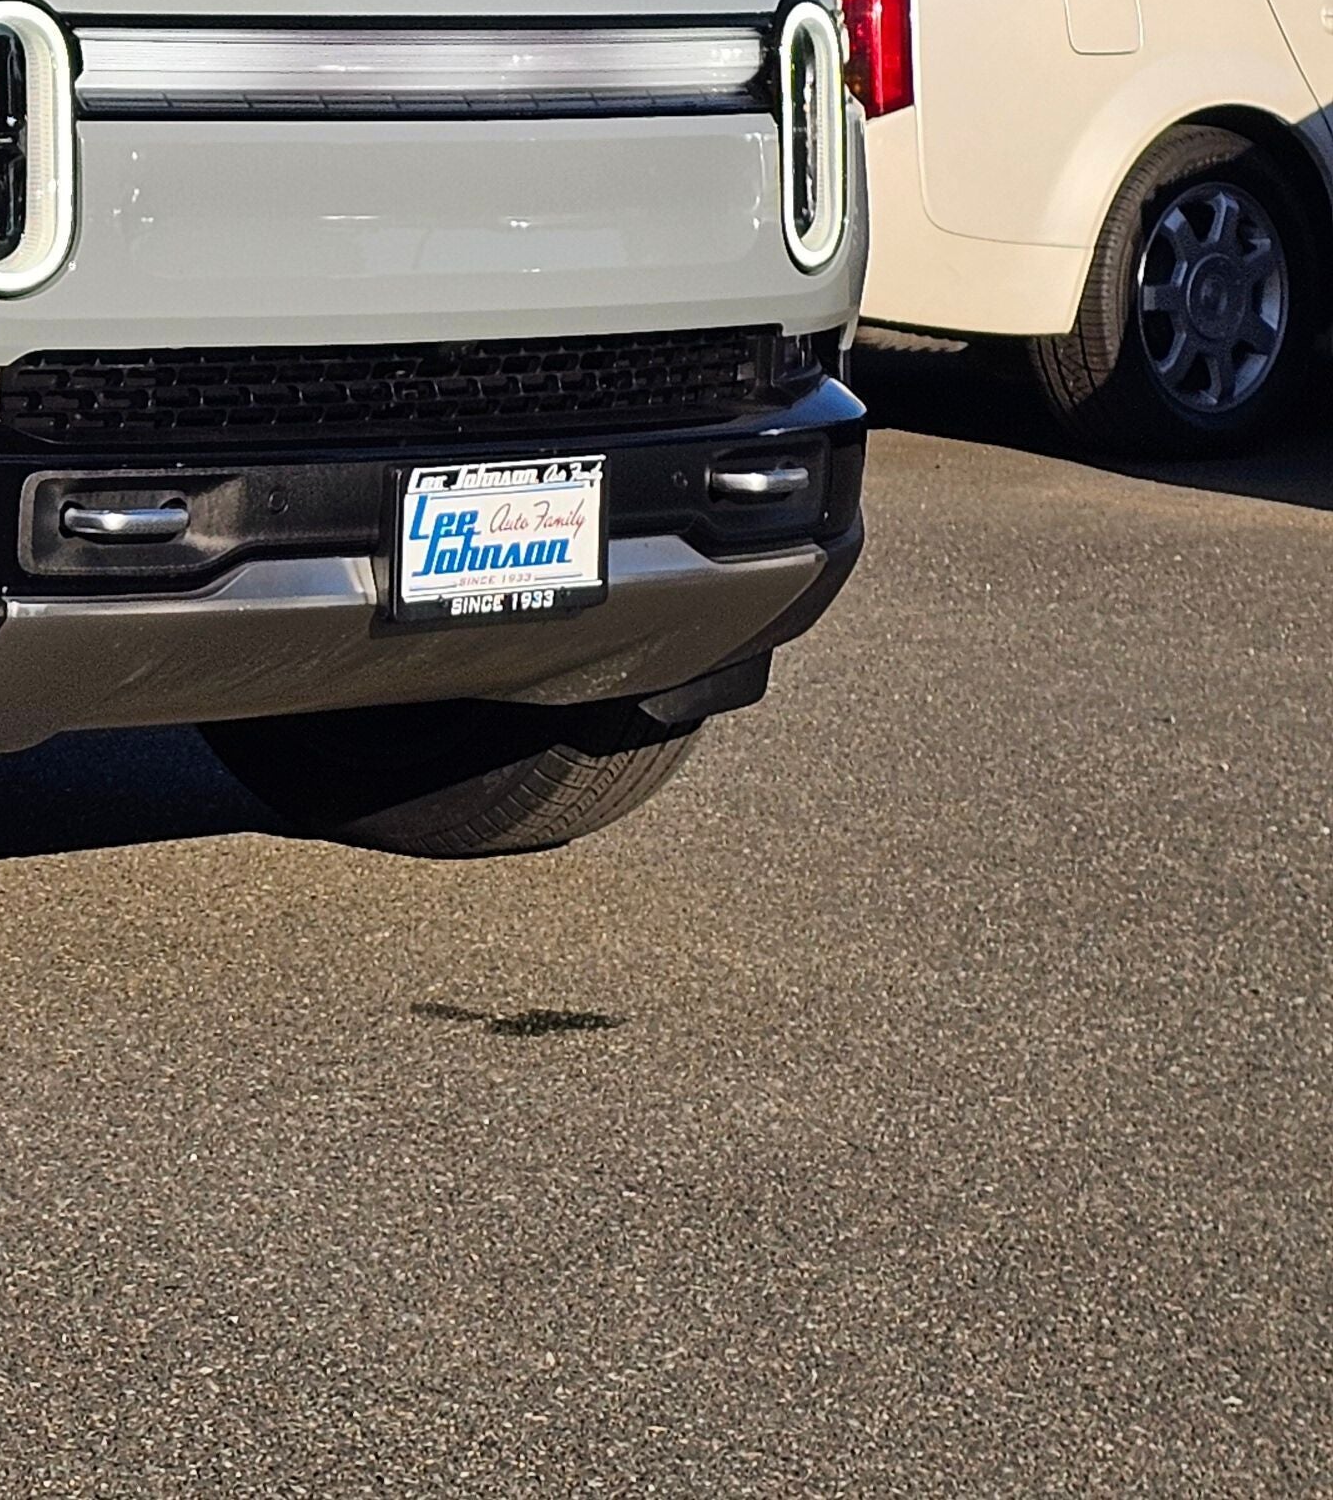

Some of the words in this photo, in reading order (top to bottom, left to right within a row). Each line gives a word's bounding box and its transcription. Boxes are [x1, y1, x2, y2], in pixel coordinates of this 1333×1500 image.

[408, 494, 482, 540] Lee
[490, 503, 529, 534] Auto
[533, 498, 587, 539] Family
[411, 533, 573, 577] Johnson
[458, 575, 496, 586] SINCE
[501, 572, 533, 584] 1933
[450, 594, 504, 615] SINCE
[511, 590, 555, 611] 1933
